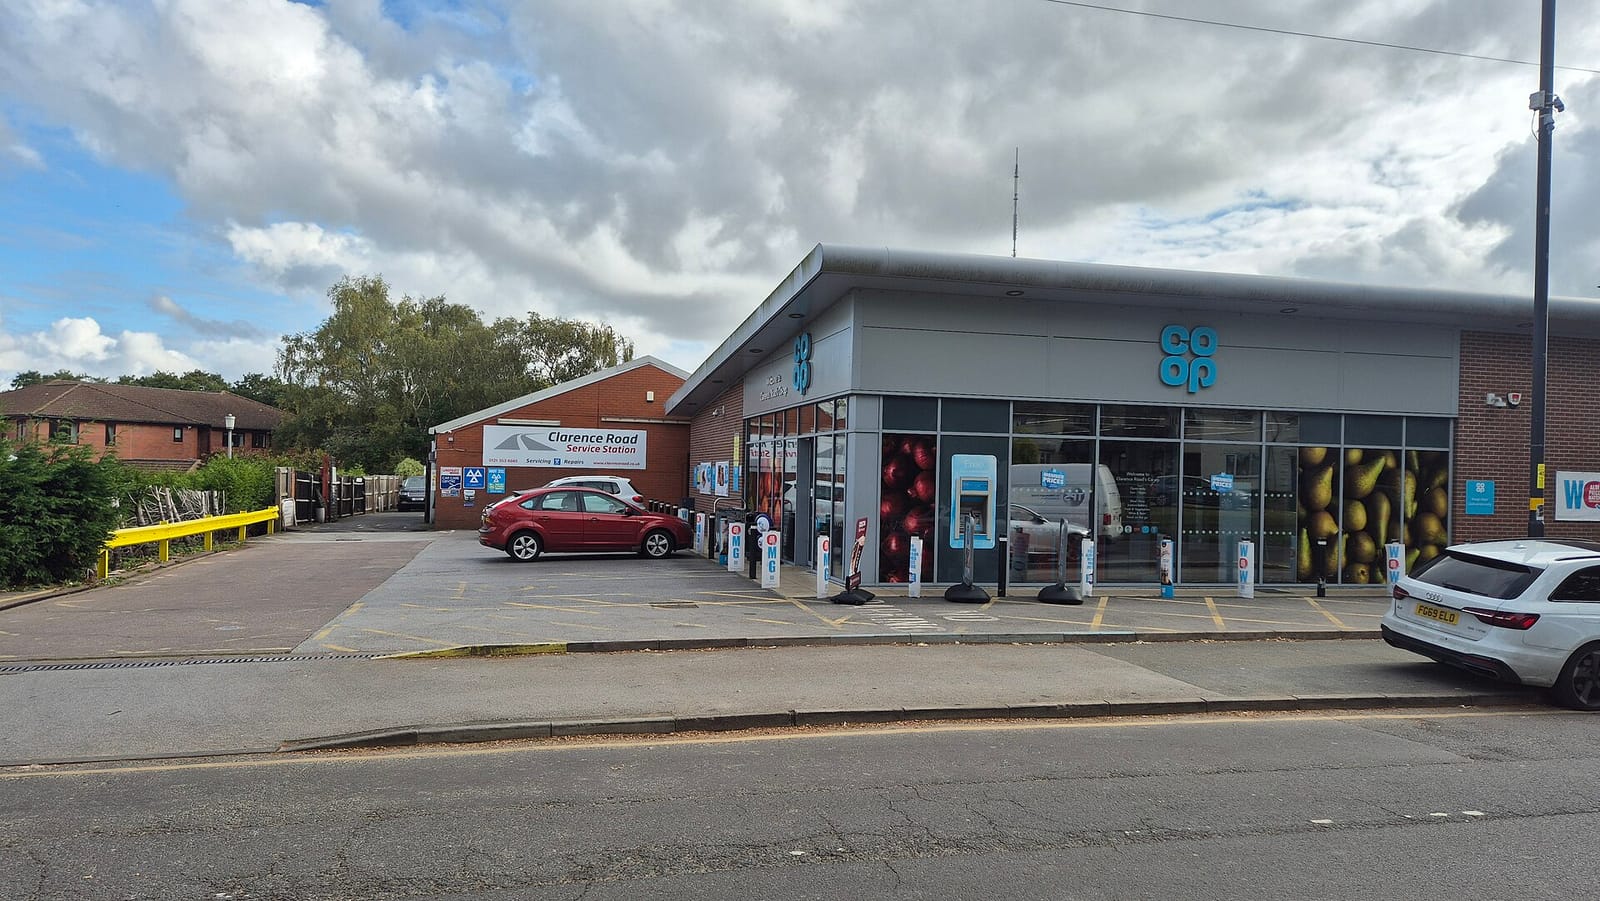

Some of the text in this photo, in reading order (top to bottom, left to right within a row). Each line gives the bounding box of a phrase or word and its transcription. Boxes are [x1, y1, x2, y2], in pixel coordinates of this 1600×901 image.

[548, 431, 638, 445] Clarence Road
[566, 444, 636, 454] Service Station
[1043, 477, 1065, 485] PRICES
[1417, 605, 1438, 618] FG69
